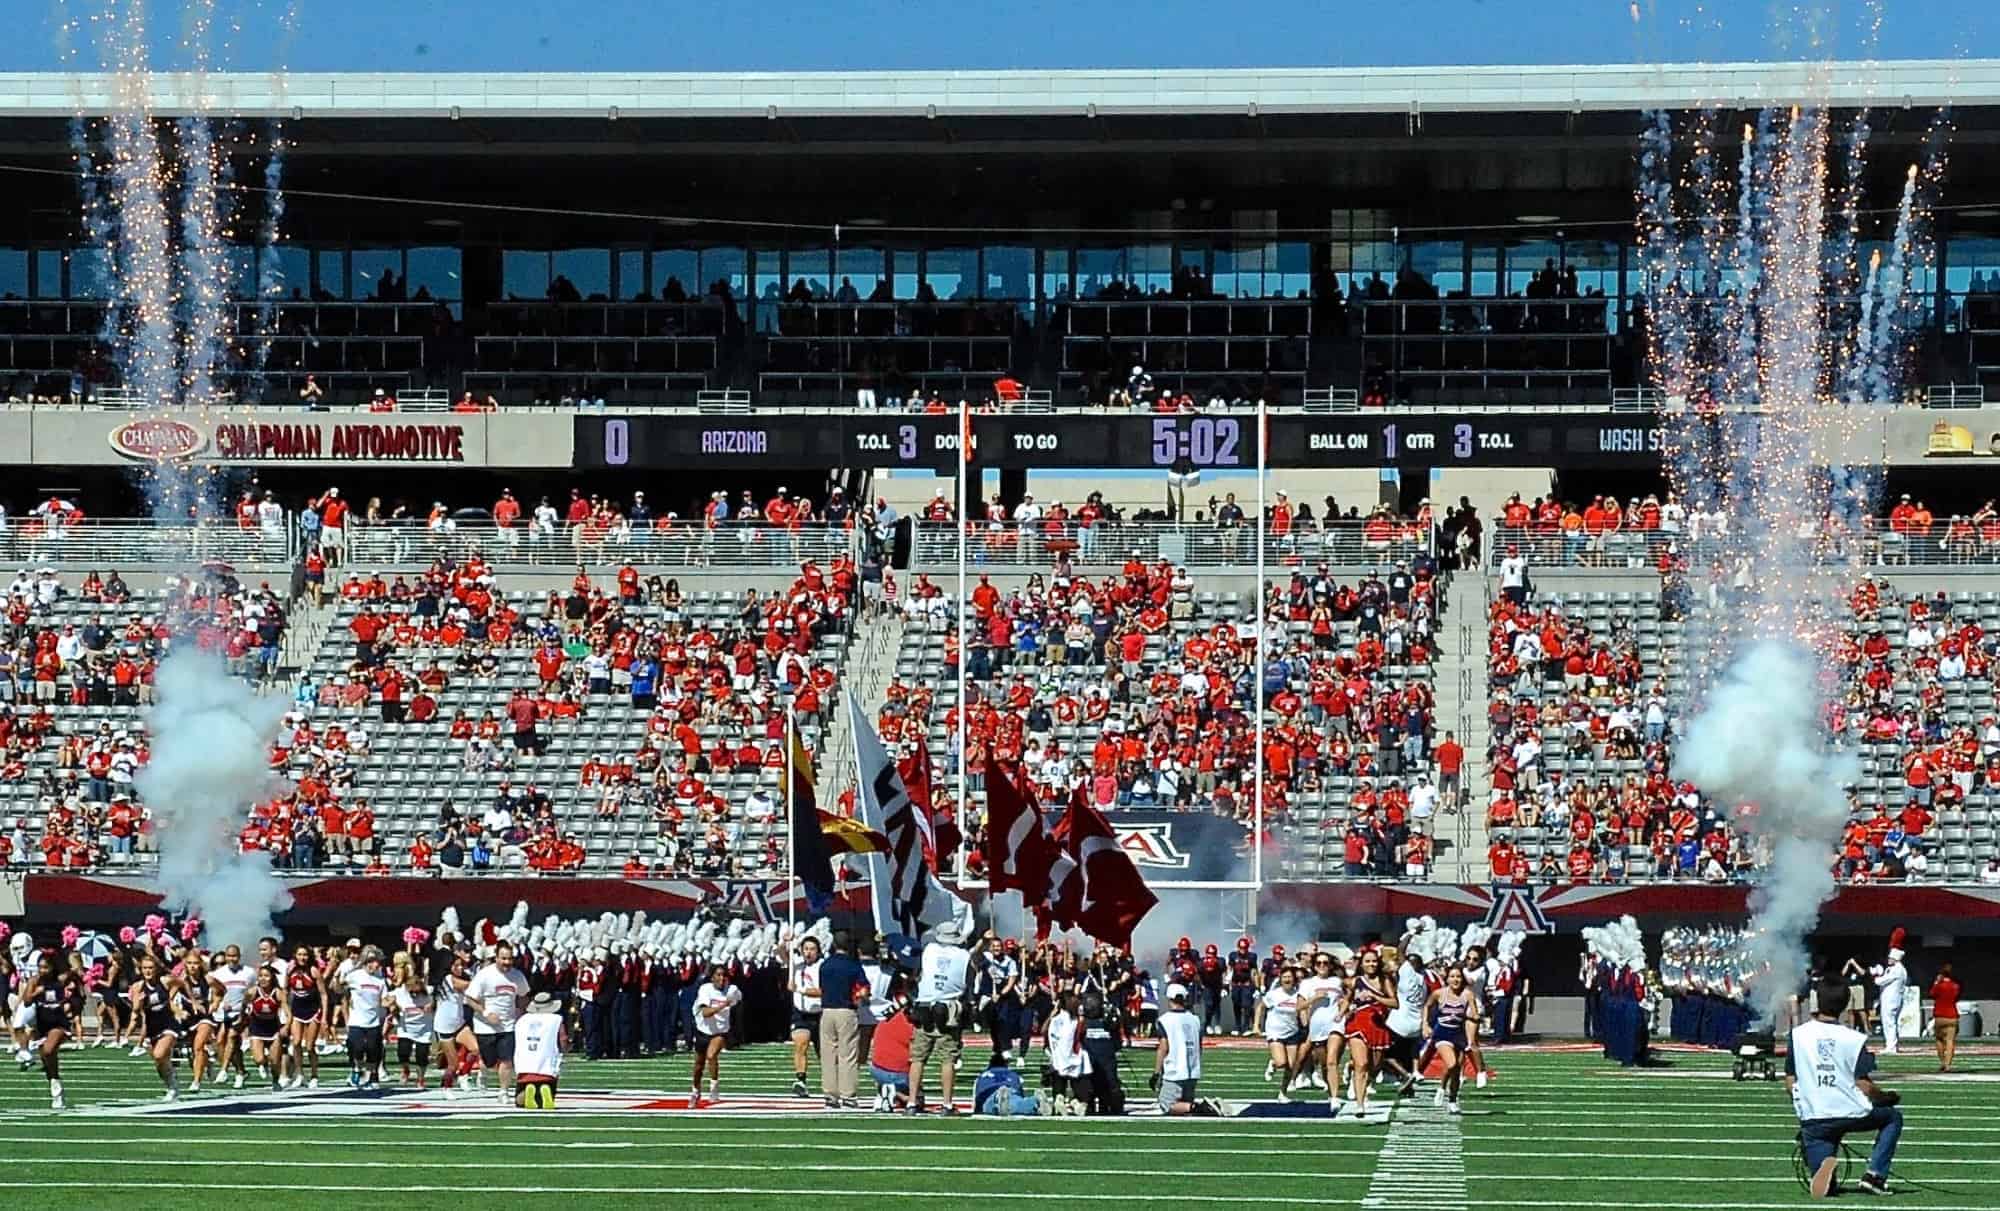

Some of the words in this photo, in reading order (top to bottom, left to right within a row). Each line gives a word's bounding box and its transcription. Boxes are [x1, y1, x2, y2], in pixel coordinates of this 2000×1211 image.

[216, 424, 321, 458] CHAPMAN
[332, 425, 464, 460] AUTOMOTIVE
[605, 419, 628, 465] 0
[702, 431, 767, 453] ARIZONA
[900, 425, 917, 459] 3
[1014, 434, 1034, 449] TO
[1037, 434, 1058, 449] GO
[1153, 418, 1239, 464] 5:02
[1310, 434, 1345, 449] BALL
[1347, 434, 1368, 449] ON
[1383, 423, 1397, 458] 1
[1406, 434, 1434, 449] QTR
[1454, 423, 1472, 458] 3
[1600, 429, 1643, 451] WASH
[1474, 880, 1555, 935] A
[1817, 1074, 1837, 1087] 142
